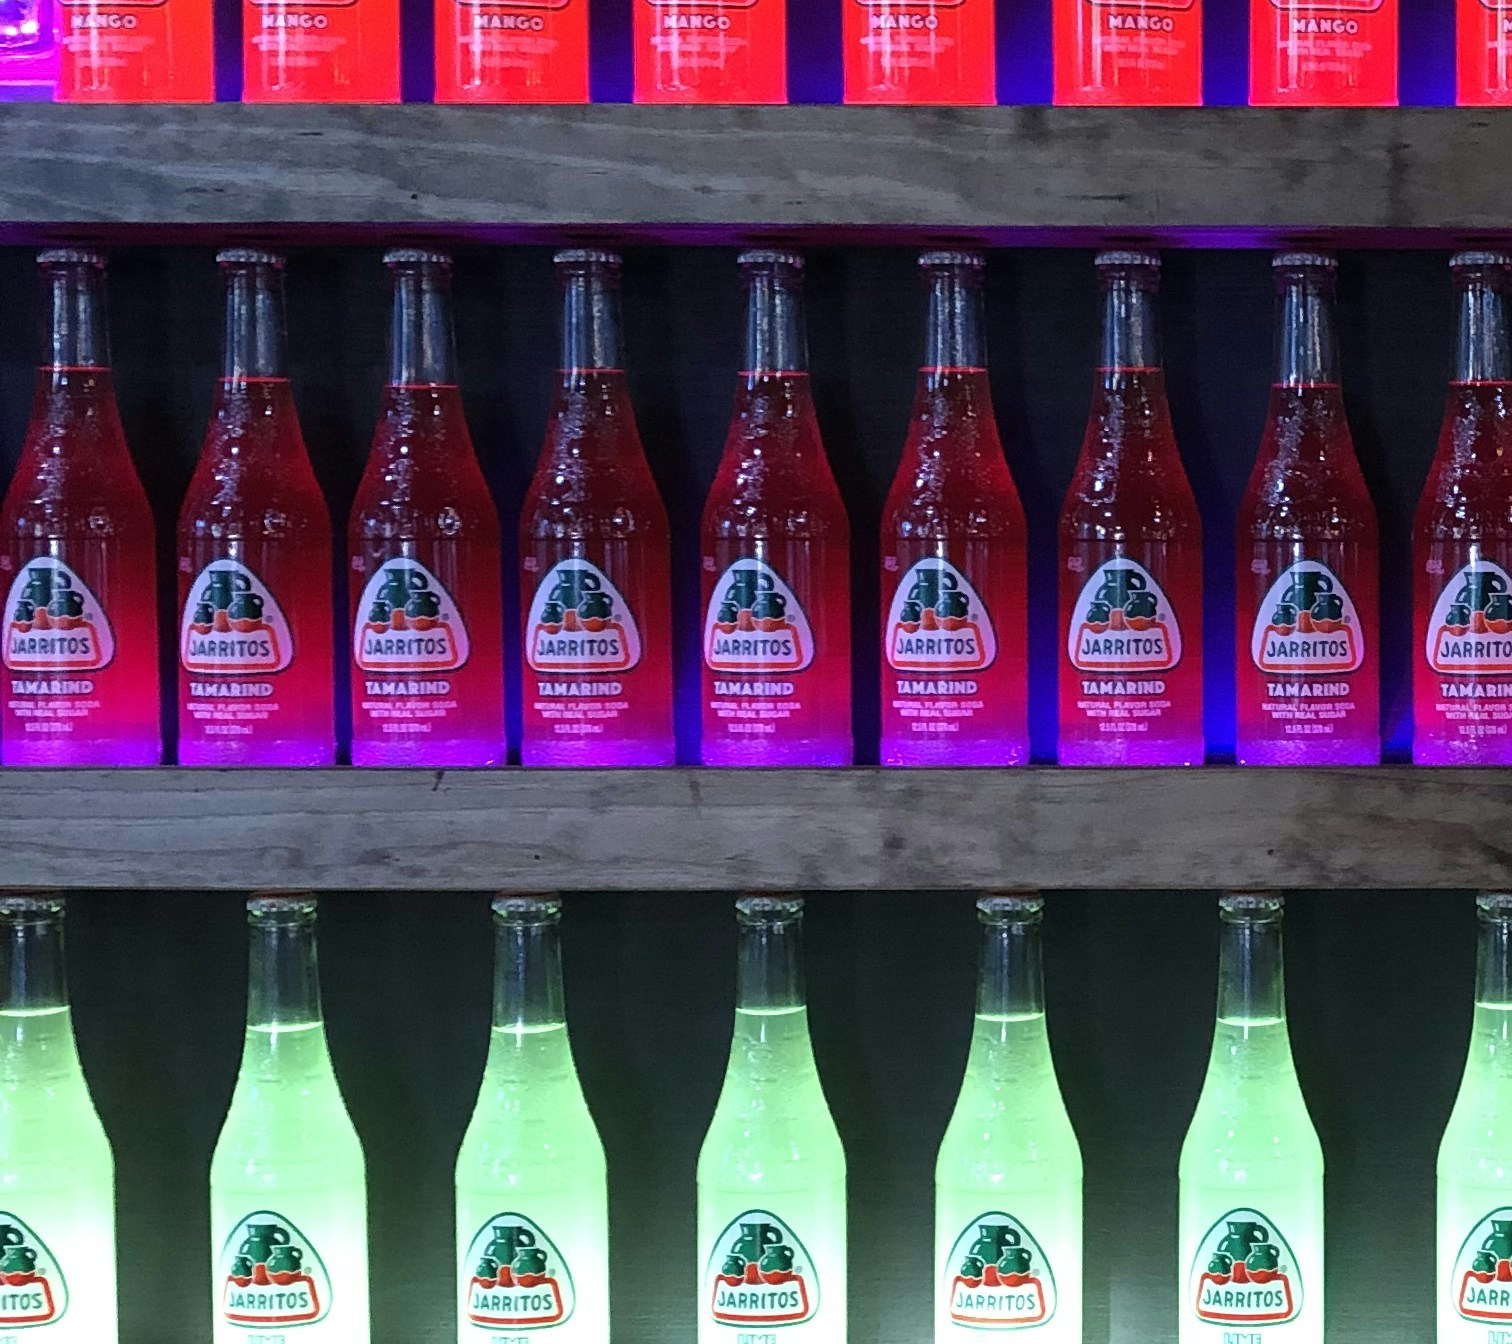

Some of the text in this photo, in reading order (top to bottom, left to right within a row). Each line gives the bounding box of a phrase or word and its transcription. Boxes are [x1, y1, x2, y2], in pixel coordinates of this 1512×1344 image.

[664, 14, 731, 31] MANGO
[1108, 15, 1174, 32] MANGO
[1292, 18, 1358, 35] MANGO
[11, 637, 90, 656] JARRITOS
[189, 638, 270, 658] JARRITOS
[364, 636, 447, 657] JARRITOS
[536, 638, 620, 658] JARRITOS
[713, 638, 792, 657] JARRITOS
[896, 636, 976, 656] JARRITOS
[1081, 638, 1164, 658] JARRITOS
[1266, 640, 1348, 660] JARRITOS
[11, 680, 94, 696] TAMARIND
[1081, 680, 1166, 697] TAMARIND
[1267, 682, 1350, 698] TAMARIND
[229, 1291, 308, 1311] JARRITOS
[473, 1293, 553, 1311] JARRITOS
[716, 1290, 799, 1310] JARRITOS
[955, 1291, 1036, 1311] JARRITOS
[1202, 1288, 1284, 1308] JARRITOS
